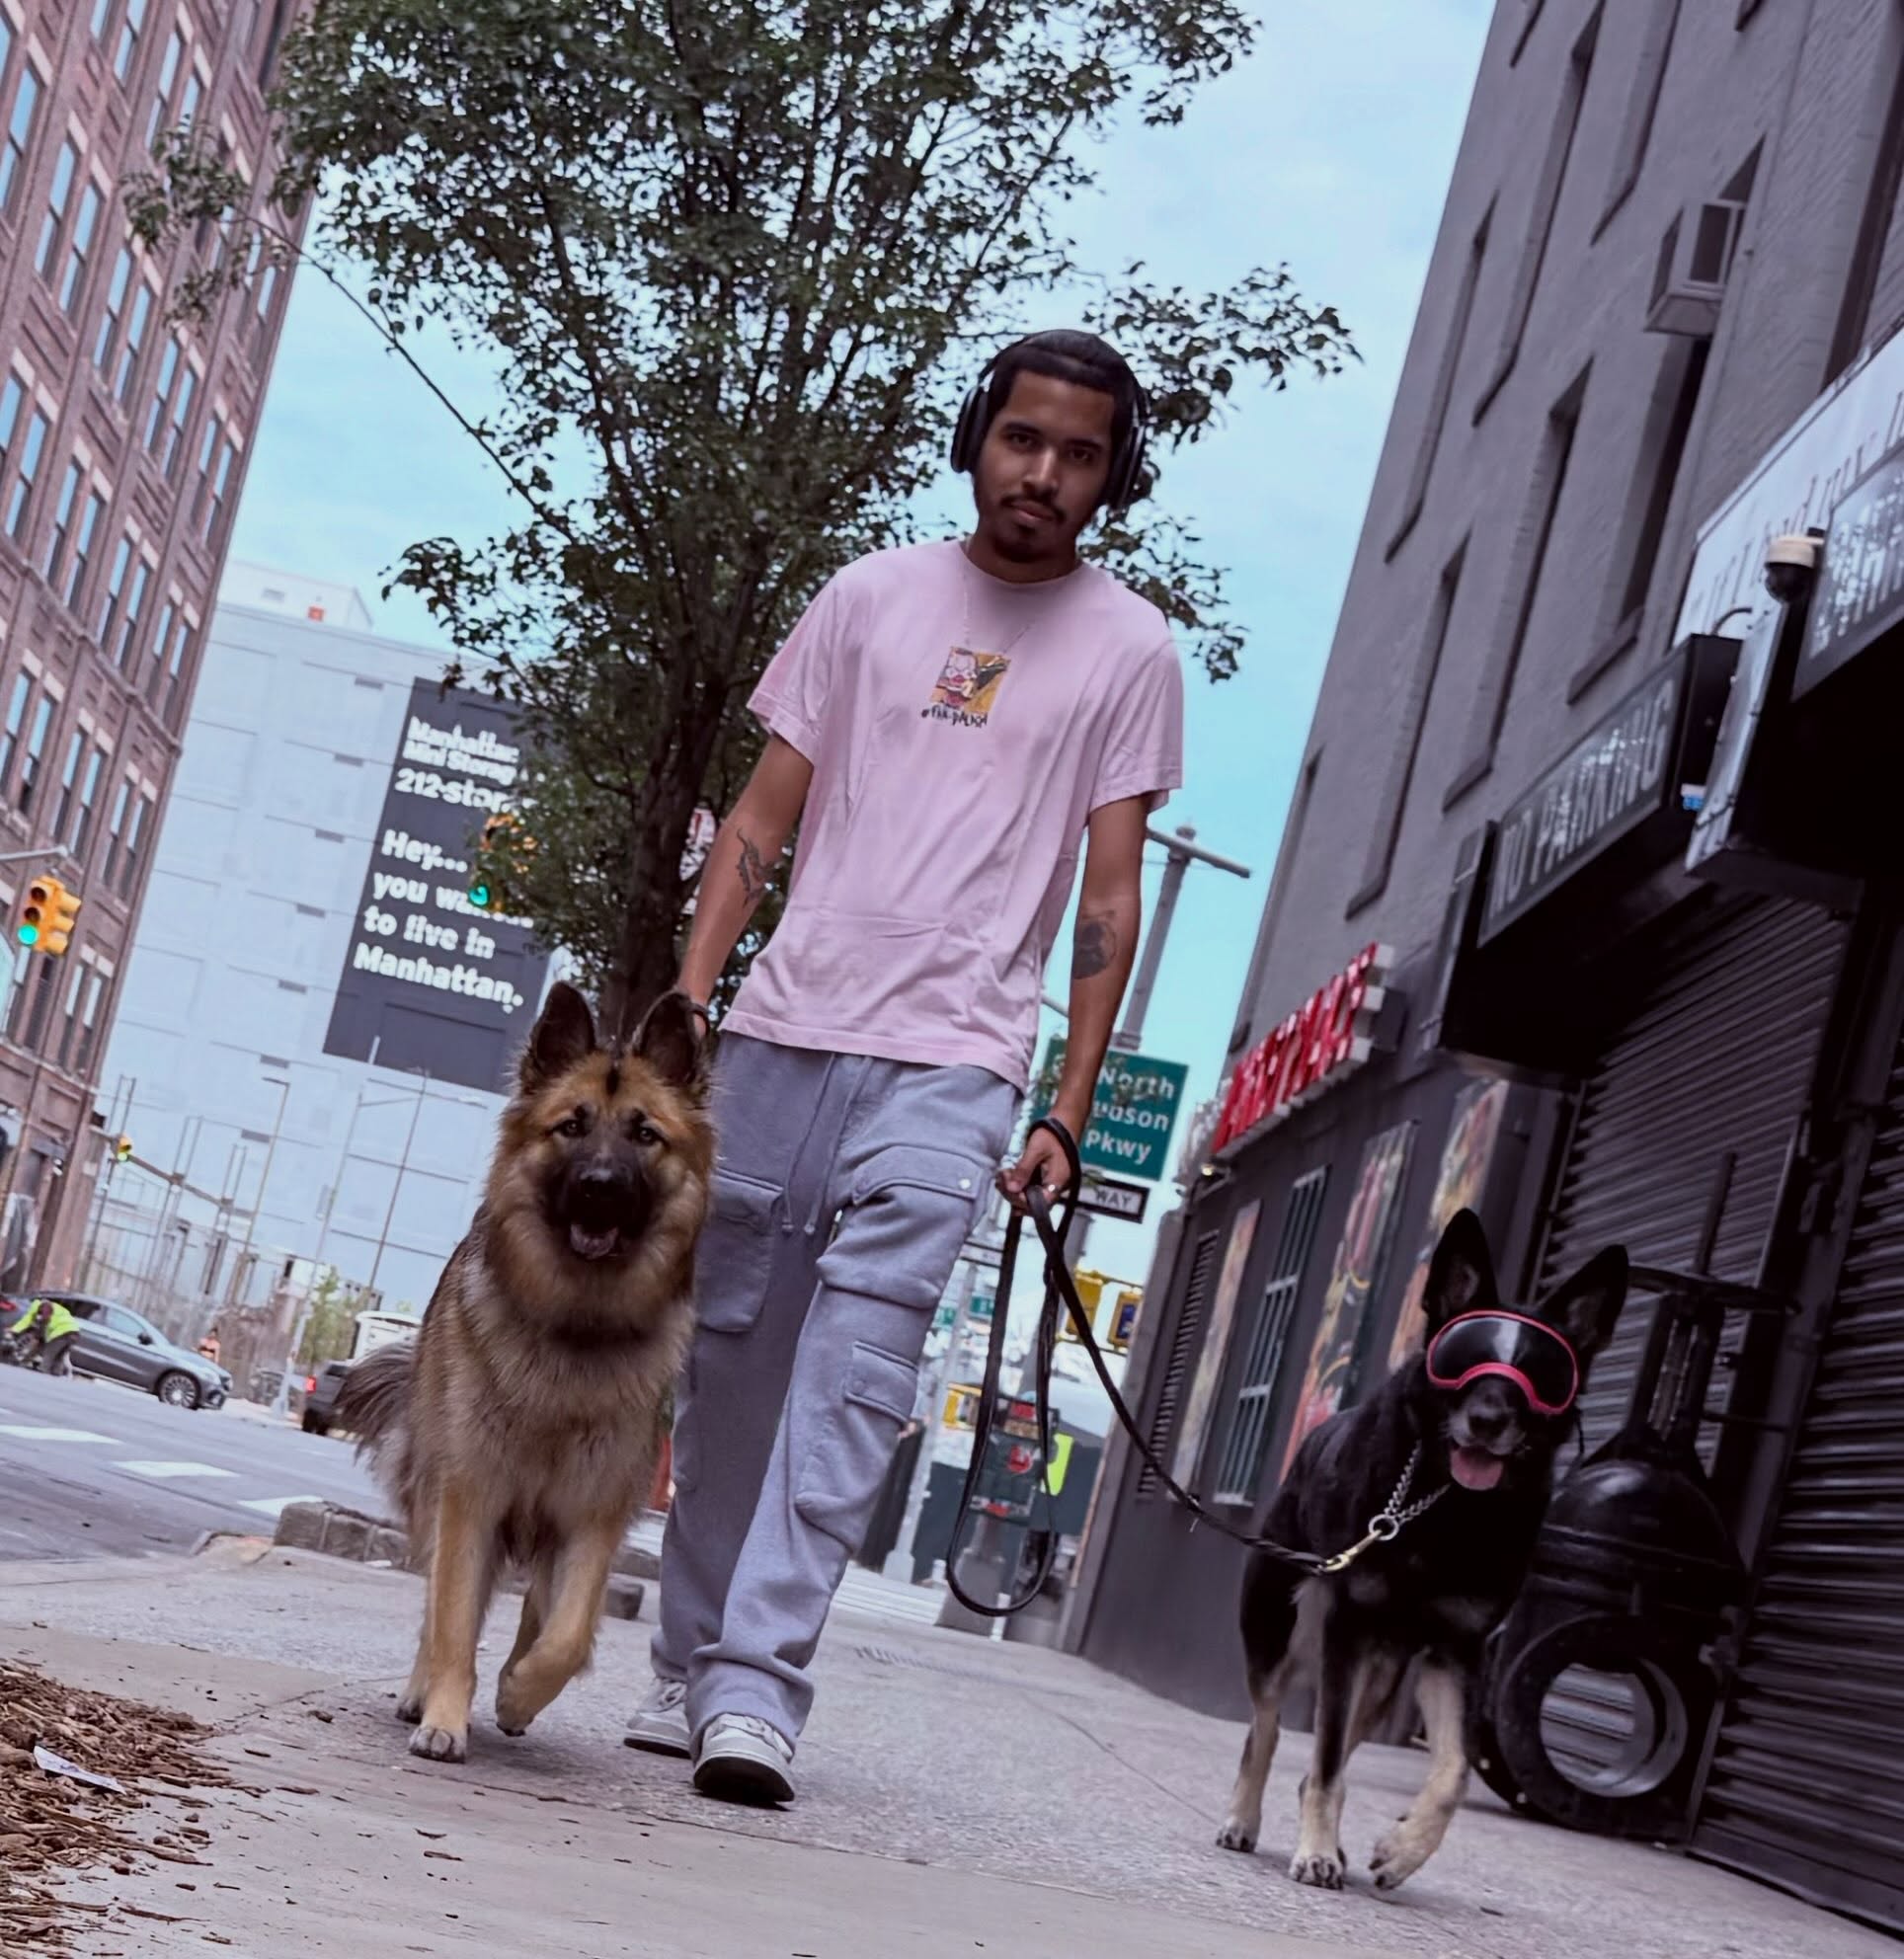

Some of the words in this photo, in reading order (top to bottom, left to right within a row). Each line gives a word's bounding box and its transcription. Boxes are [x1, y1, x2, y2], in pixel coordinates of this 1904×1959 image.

[446, 749, 519, 786] Storag
[372, 871, 429, 904] you
[362, 904, 398, 936] to
[403, 913, 459, 951] live
[464, 926, 496, 960] in
[353, 941, 524, 1009] Manhattan.
[1097, 1065, 1175, 1101] North
[1085, 1128, 1151, 1166] Pkwy
[1093, 1187, 1132, 1210] WAY
